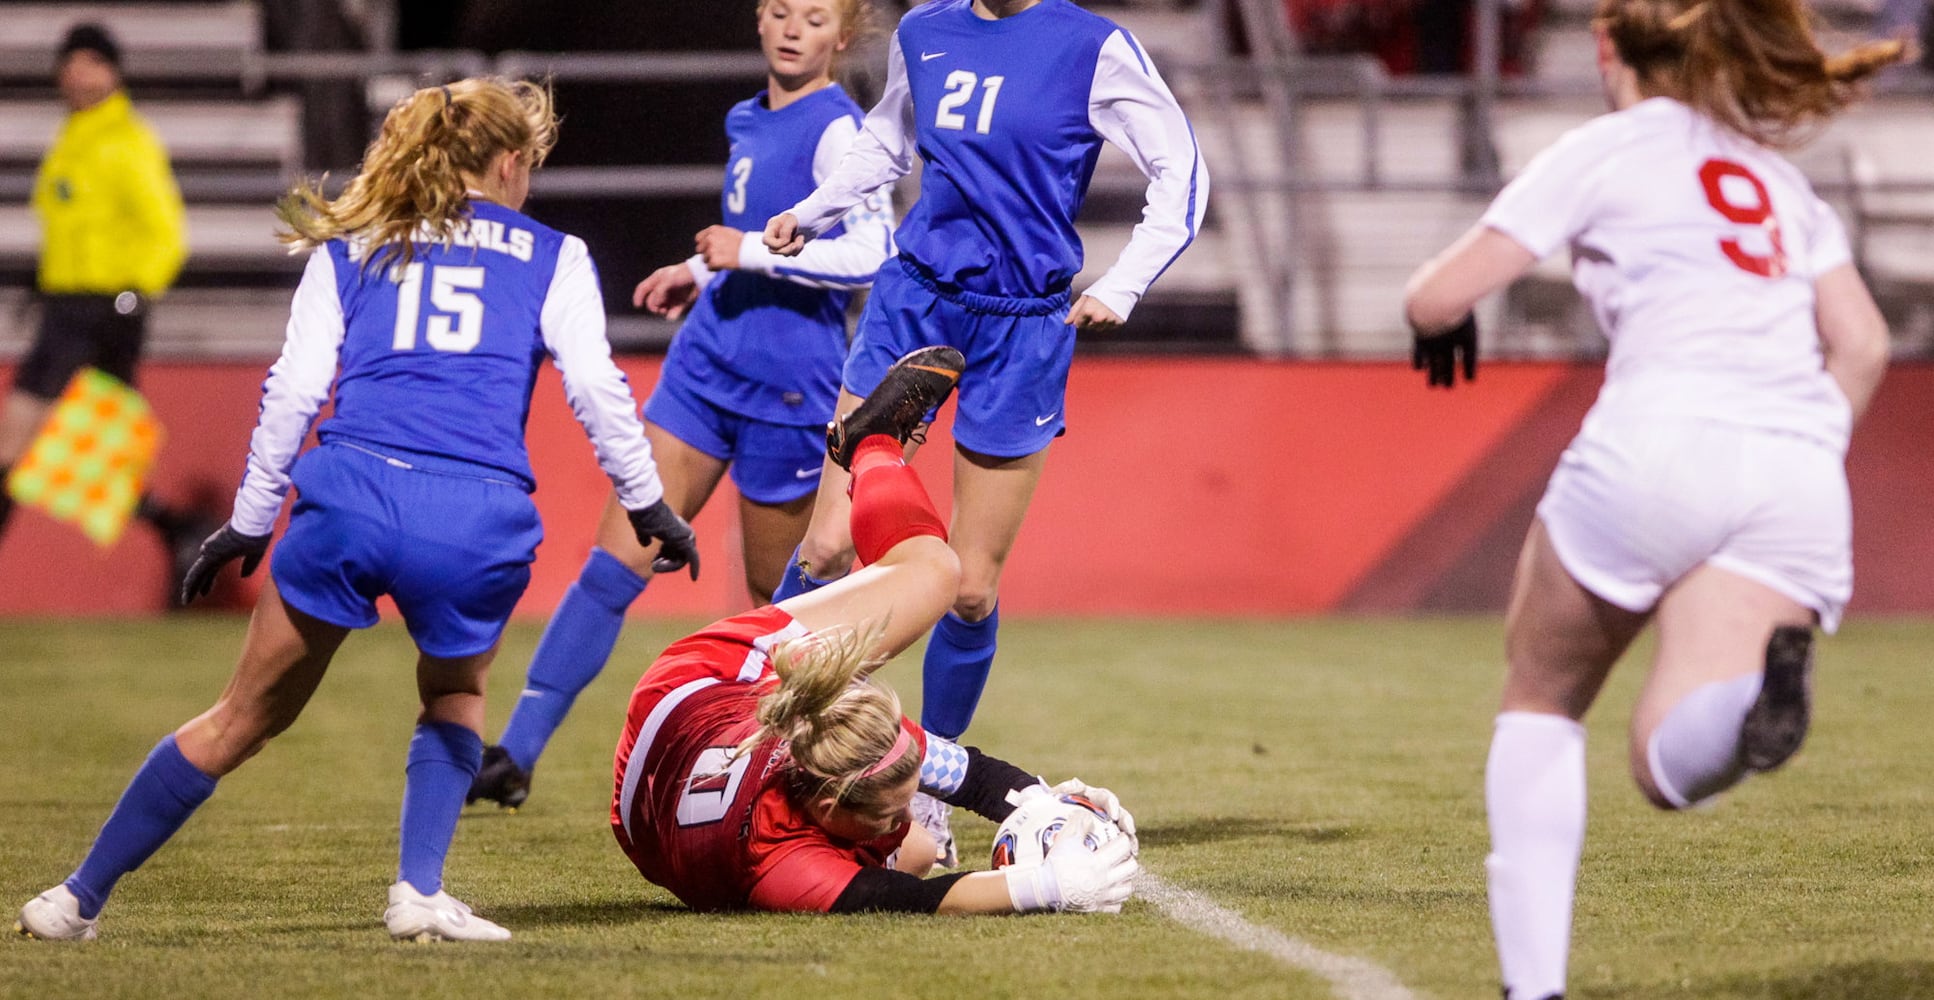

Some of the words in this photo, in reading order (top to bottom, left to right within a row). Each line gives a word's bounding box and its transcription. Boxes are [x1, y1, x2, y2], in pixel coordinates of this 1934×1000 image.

[935, 69, 1005, 135] 21
[727, 157, 753, 215] 3
[1699, 158, 1786, 278] 9
[392, 262, 485, 353] 15
